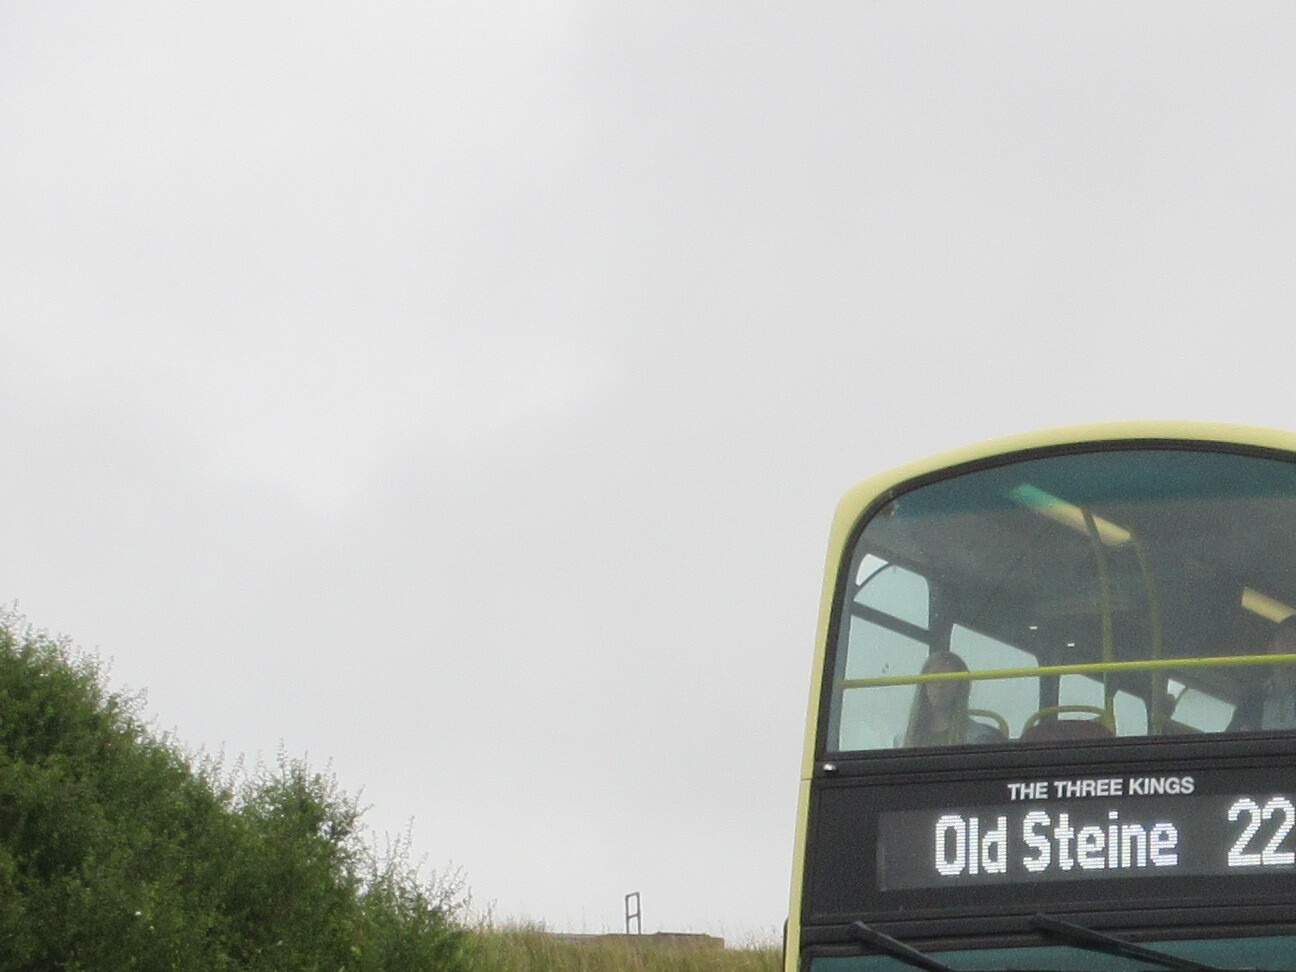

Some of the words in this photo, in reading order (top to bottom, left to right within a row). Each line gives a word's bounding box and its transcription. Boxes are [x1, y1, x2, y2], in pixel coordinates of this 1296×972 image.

[1008, 781, 1049, 801] THE
[1053, 778, 1124, 799] THREE
[1128, 776, 1195, 797] KINGS
[933, 814, 1007, 876] Old
[1021, 809, 1179, 873] Steine
[1227, 796, 1296, 867] 22
